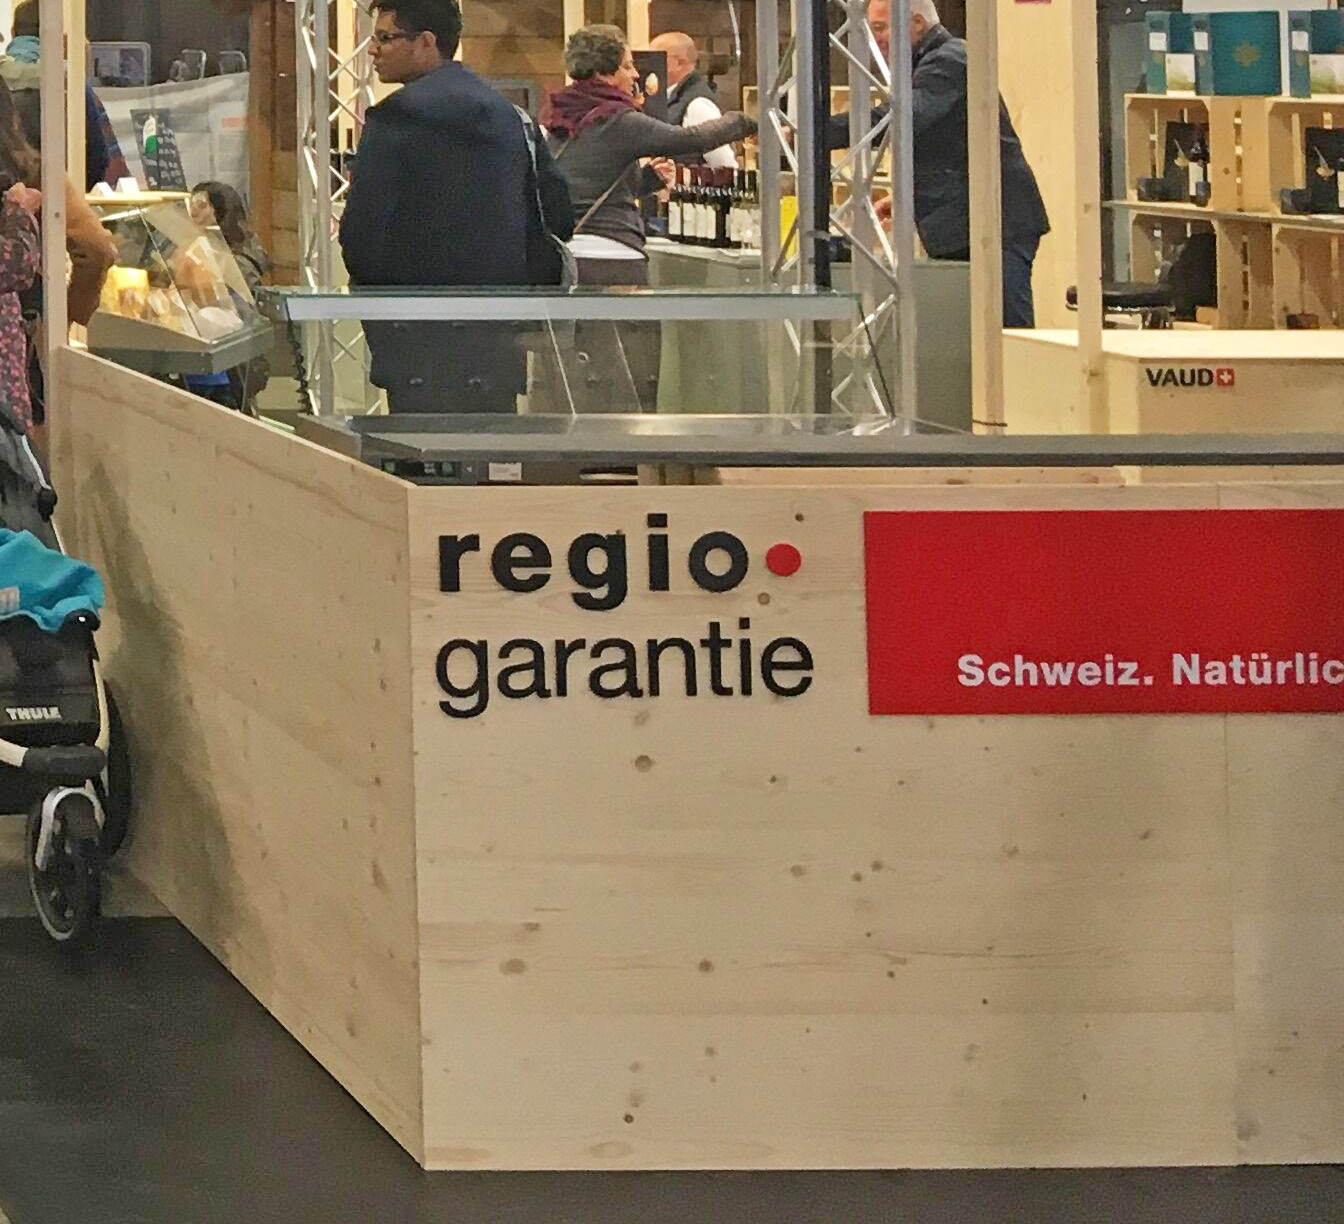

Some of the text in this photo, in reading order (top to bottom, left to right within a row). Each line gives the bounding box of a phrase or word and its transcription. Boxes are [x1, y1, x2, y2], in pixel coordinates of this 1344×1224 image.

[1145, 368, 1214, 387] VAUD
[435, 617, 814, 720] garantie
[957, 652, 1154, 688] Schweiz.
[5, 707, 62, 721] THULE
